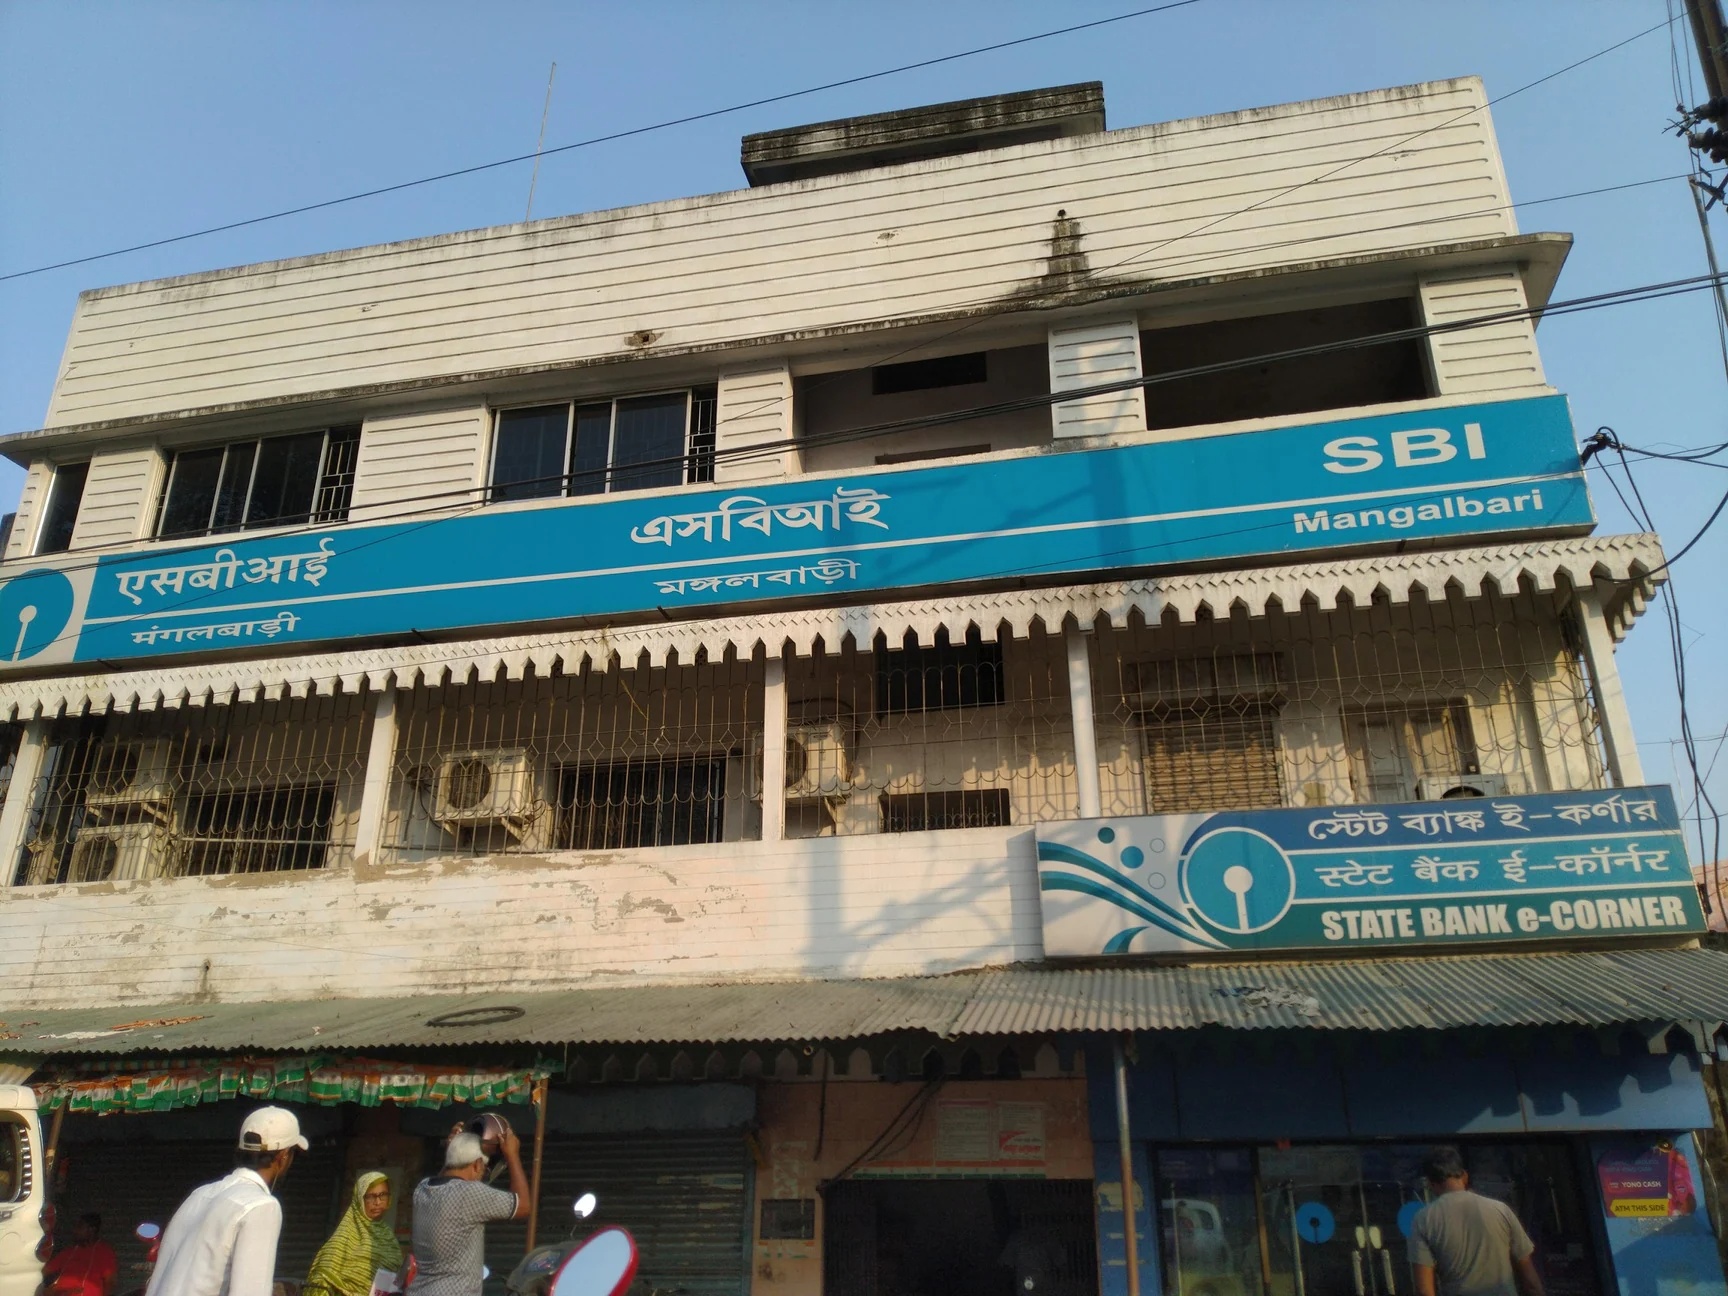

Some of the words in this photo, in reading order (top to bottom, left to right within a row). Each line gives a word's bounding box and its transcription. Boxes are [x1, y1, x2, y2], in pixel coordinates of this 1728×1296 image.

[1322, 422, 1486, 474] SBI
[630, 486, 892, 546] এসবিআই
[1293, 489, 1544, 534] Mangalbari
[115, 537, 336, 606] एसबीआई
[653, 559, 862, 596] মঙ্গলবাড়ী
[130, 611, 302, 646] मंगलबाड़ी
[1308, 809, 1391, 841] স্টেট
[1398, 809, 1486, 836] ব্যাঙ্ক
[1314, 860, 1394, 888] स्टेट
[1410, 855, 1480, 884] बैंक
[1321, 907, 1416, 941] STATE
[1420, 903, 1513, 937] BANK
[1516, 895, 1688, 933] e-CORNER
[1632, 1204, 1648, 1212] THIS
